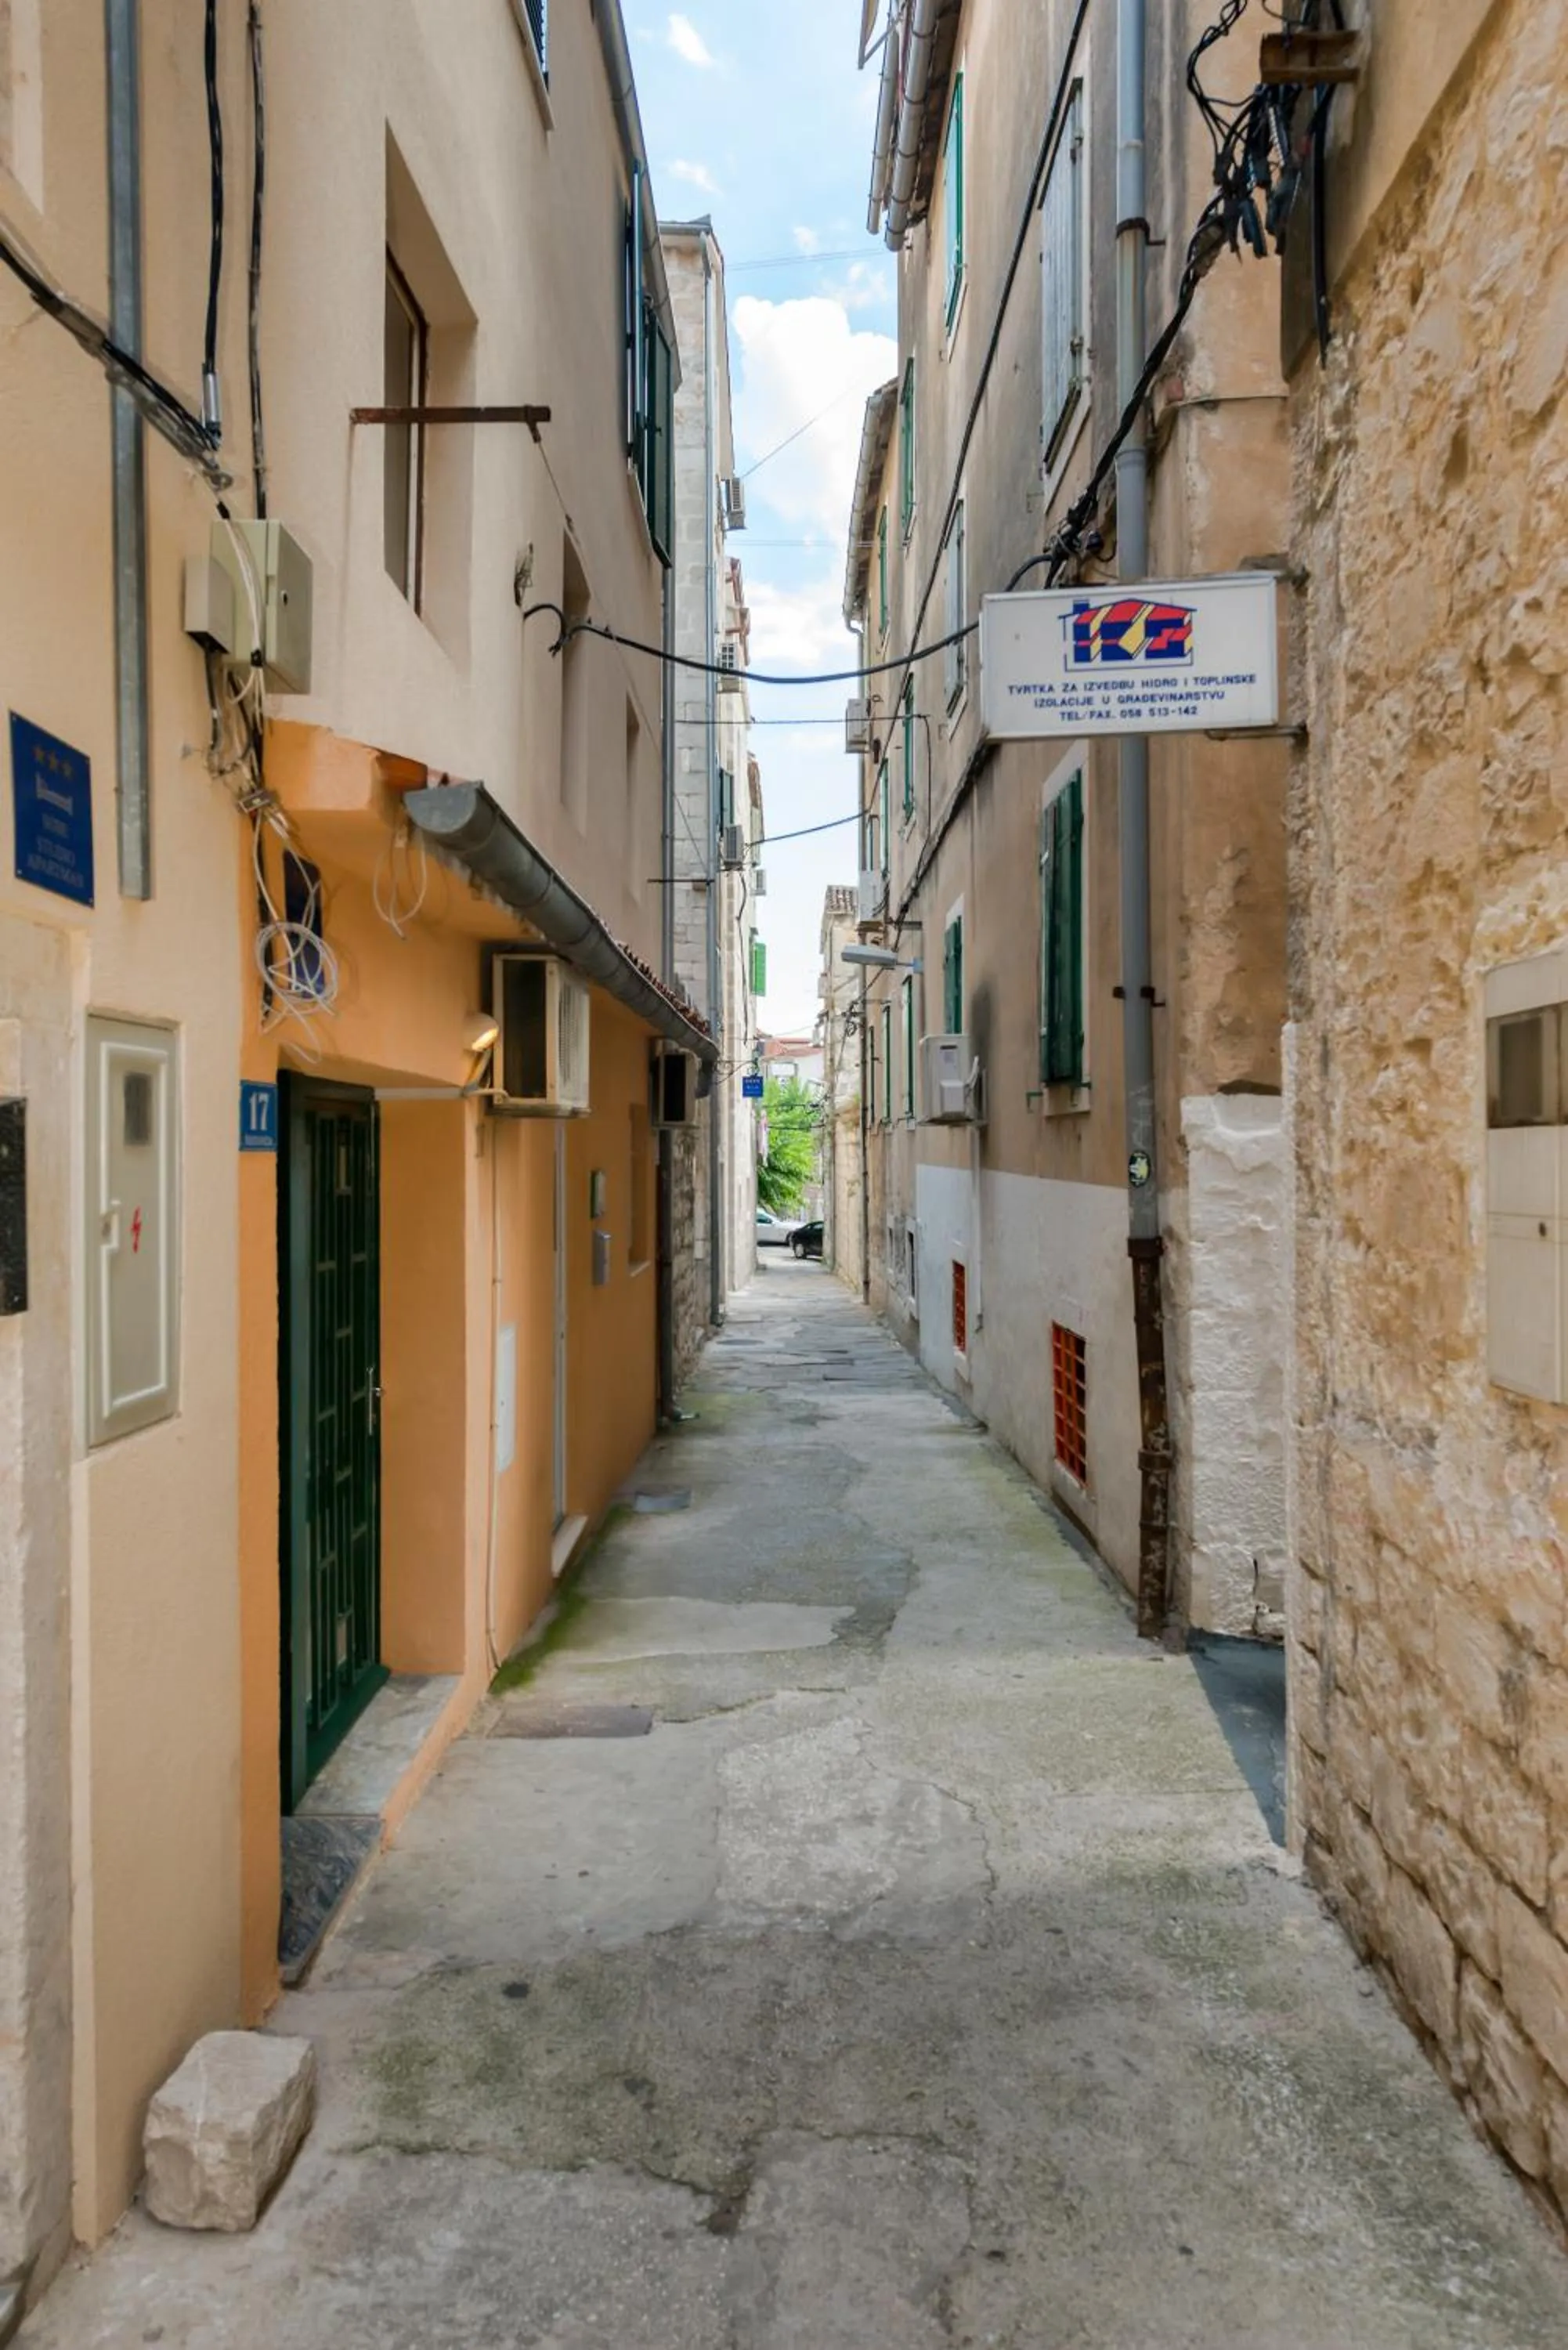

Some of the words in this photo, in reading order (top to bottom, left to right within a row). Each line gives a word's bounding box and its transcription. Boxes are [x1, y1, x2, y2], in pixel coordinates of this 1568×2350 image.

[1008, 684, 1054, 695] TVRTKA
[1062, 683, 1077, 692] ZA
[1083, 680, 1135, 691] IZVEDBU
[1141, 678, 1178, 688] HIDRO
[1194, 674, 1255, 685] TOPLINSKE
[1034, 696, 1093, 708] IZOLACIJE
[1102, 696, 1110, 704] U
[1149, 705, 1198, 717] 513-142
[249, 1092, 269, 1130] 17
